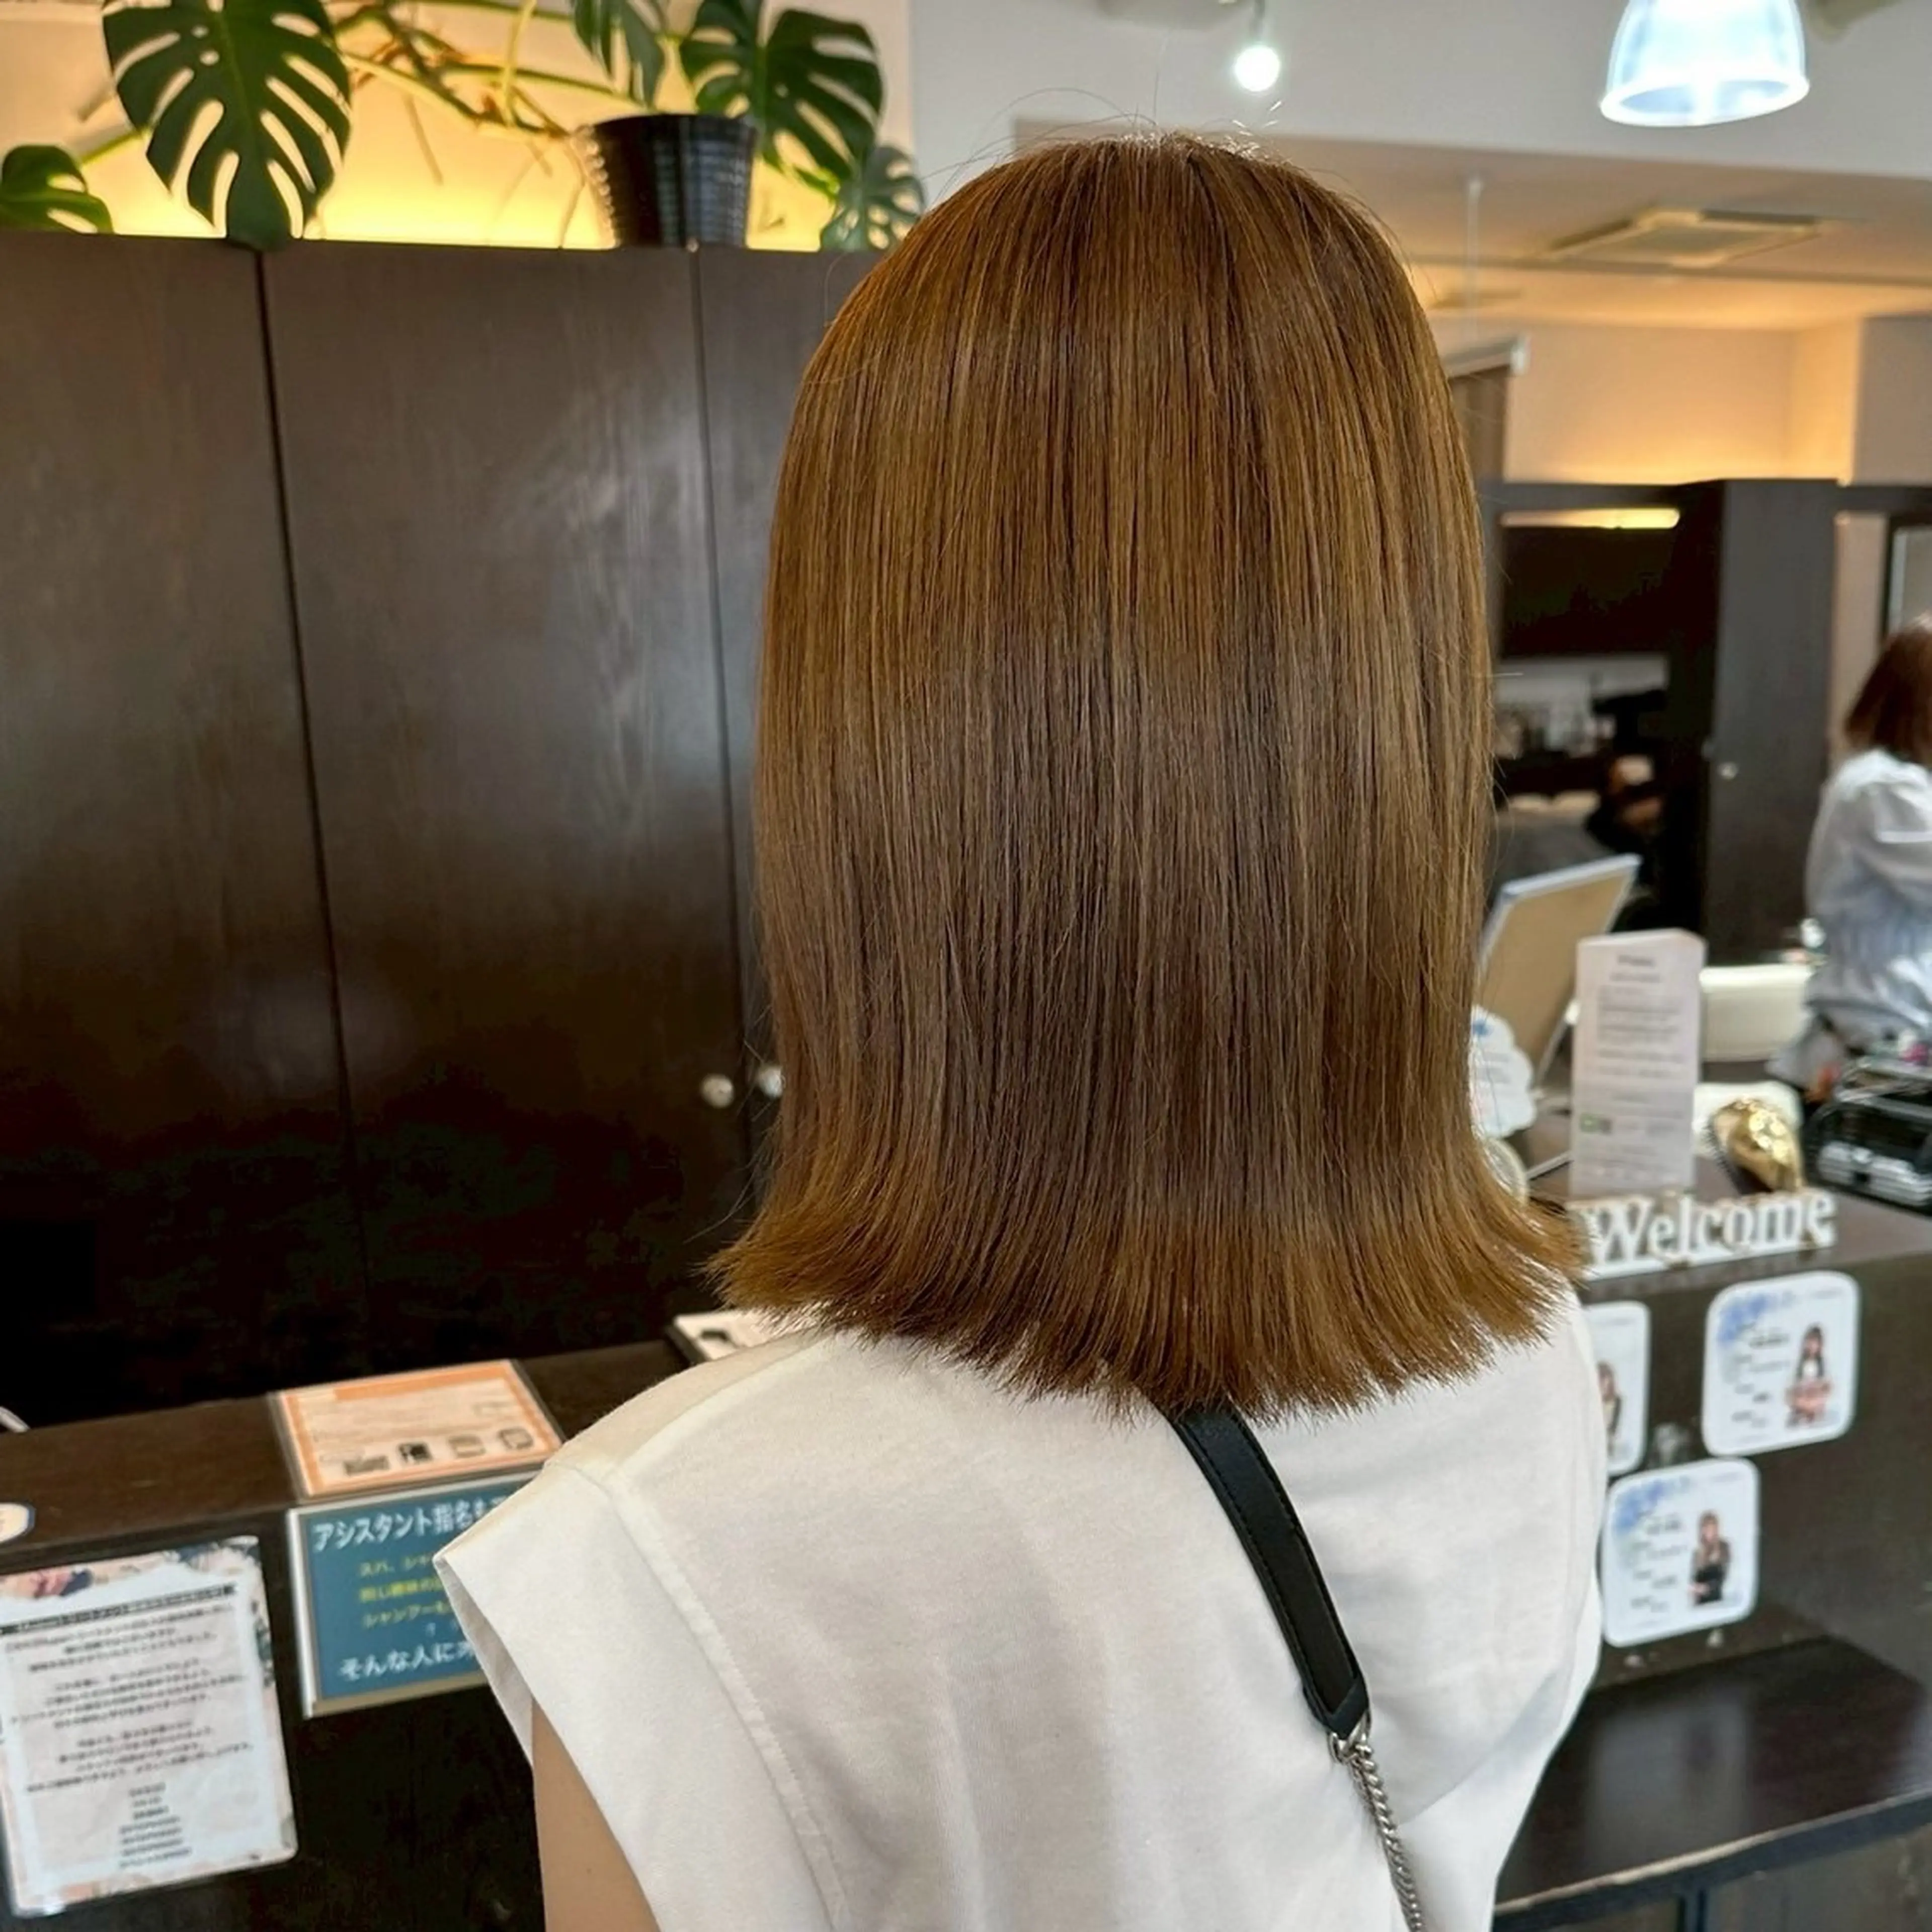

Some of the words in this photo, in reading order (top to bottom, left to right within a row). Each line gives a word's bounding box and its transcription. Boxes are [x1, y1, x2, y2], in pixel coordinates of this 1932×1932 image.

[1581, 1188, 1836, 1265] Welcome
[312, 1496, 508, 1552] アシスタント指名も
